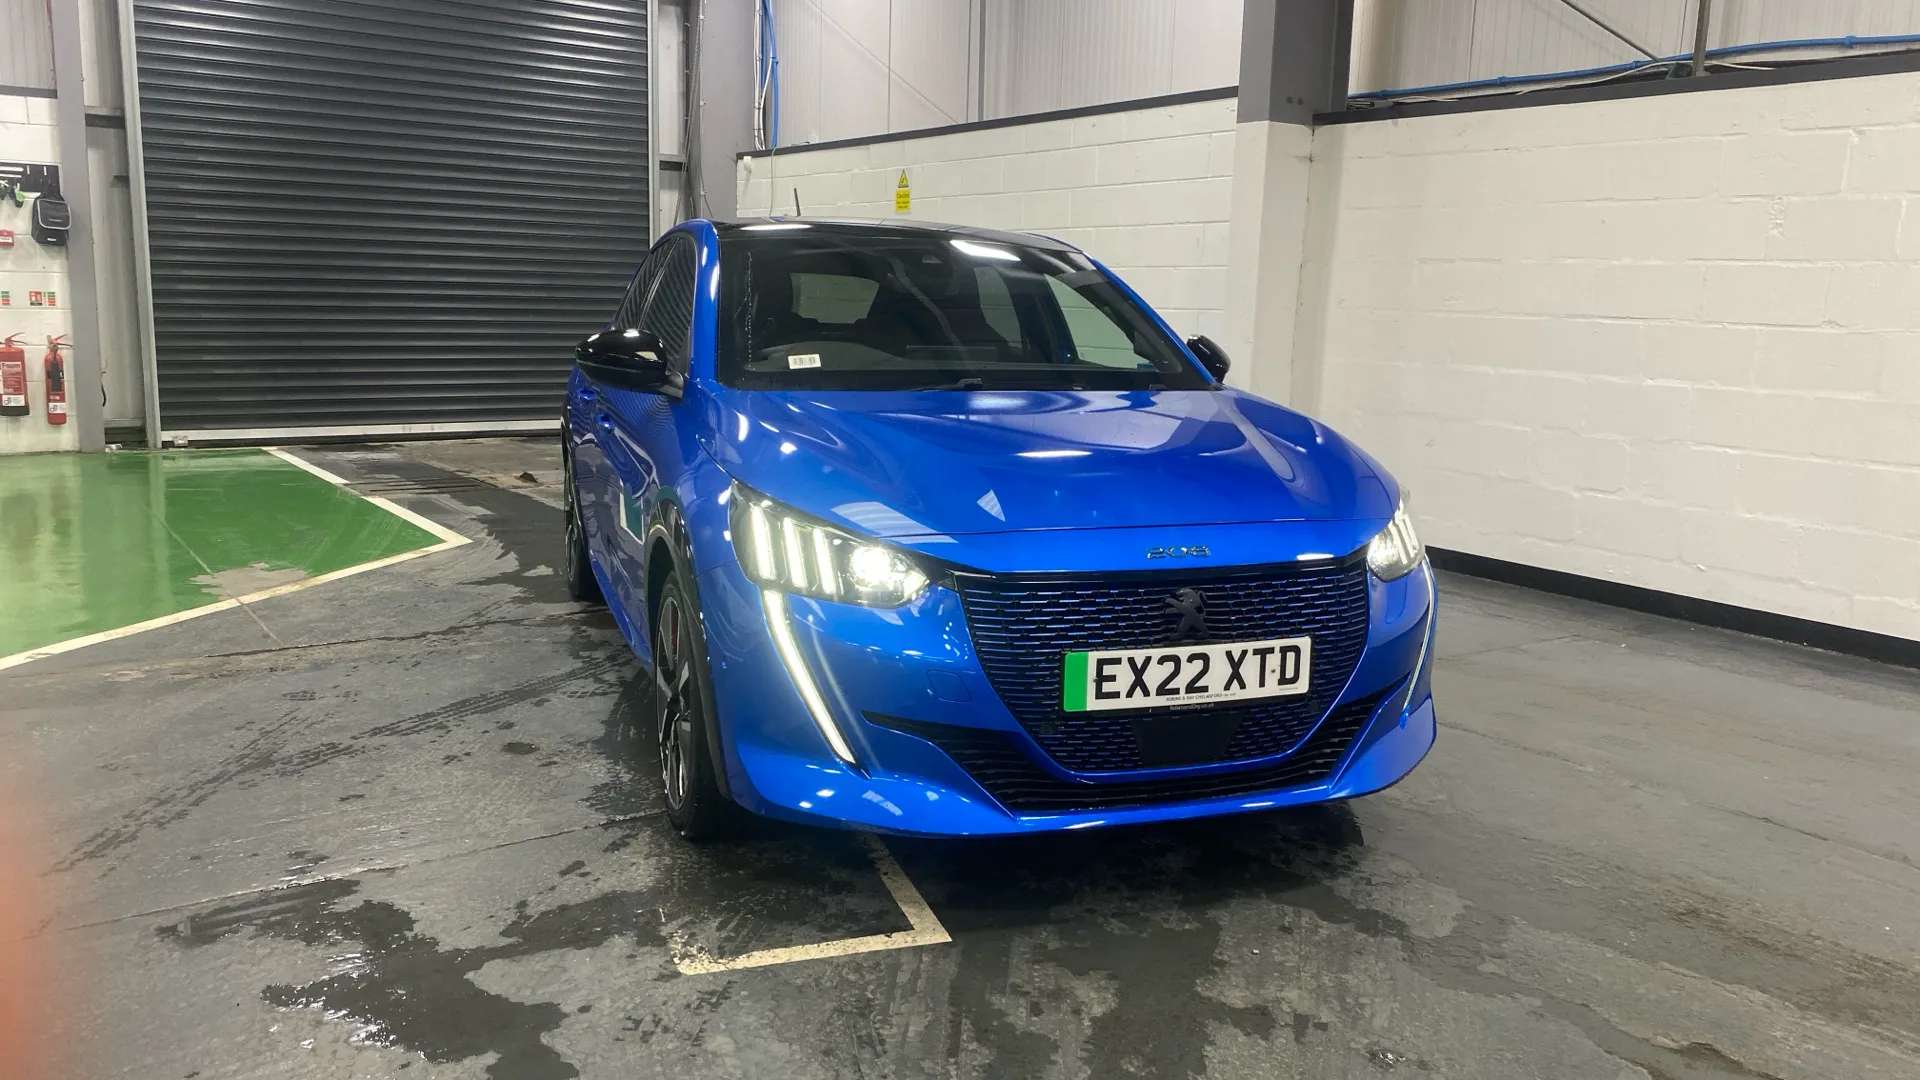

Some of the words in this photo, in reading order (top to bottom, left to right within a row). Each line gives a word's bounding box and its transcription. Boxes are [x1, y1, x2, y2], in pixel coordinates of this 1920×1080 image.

[1146, 545, 1210, 560] 208
[1095, 652, 1211, 700] EX22
[1223, 645, 1302, 691] XTD
